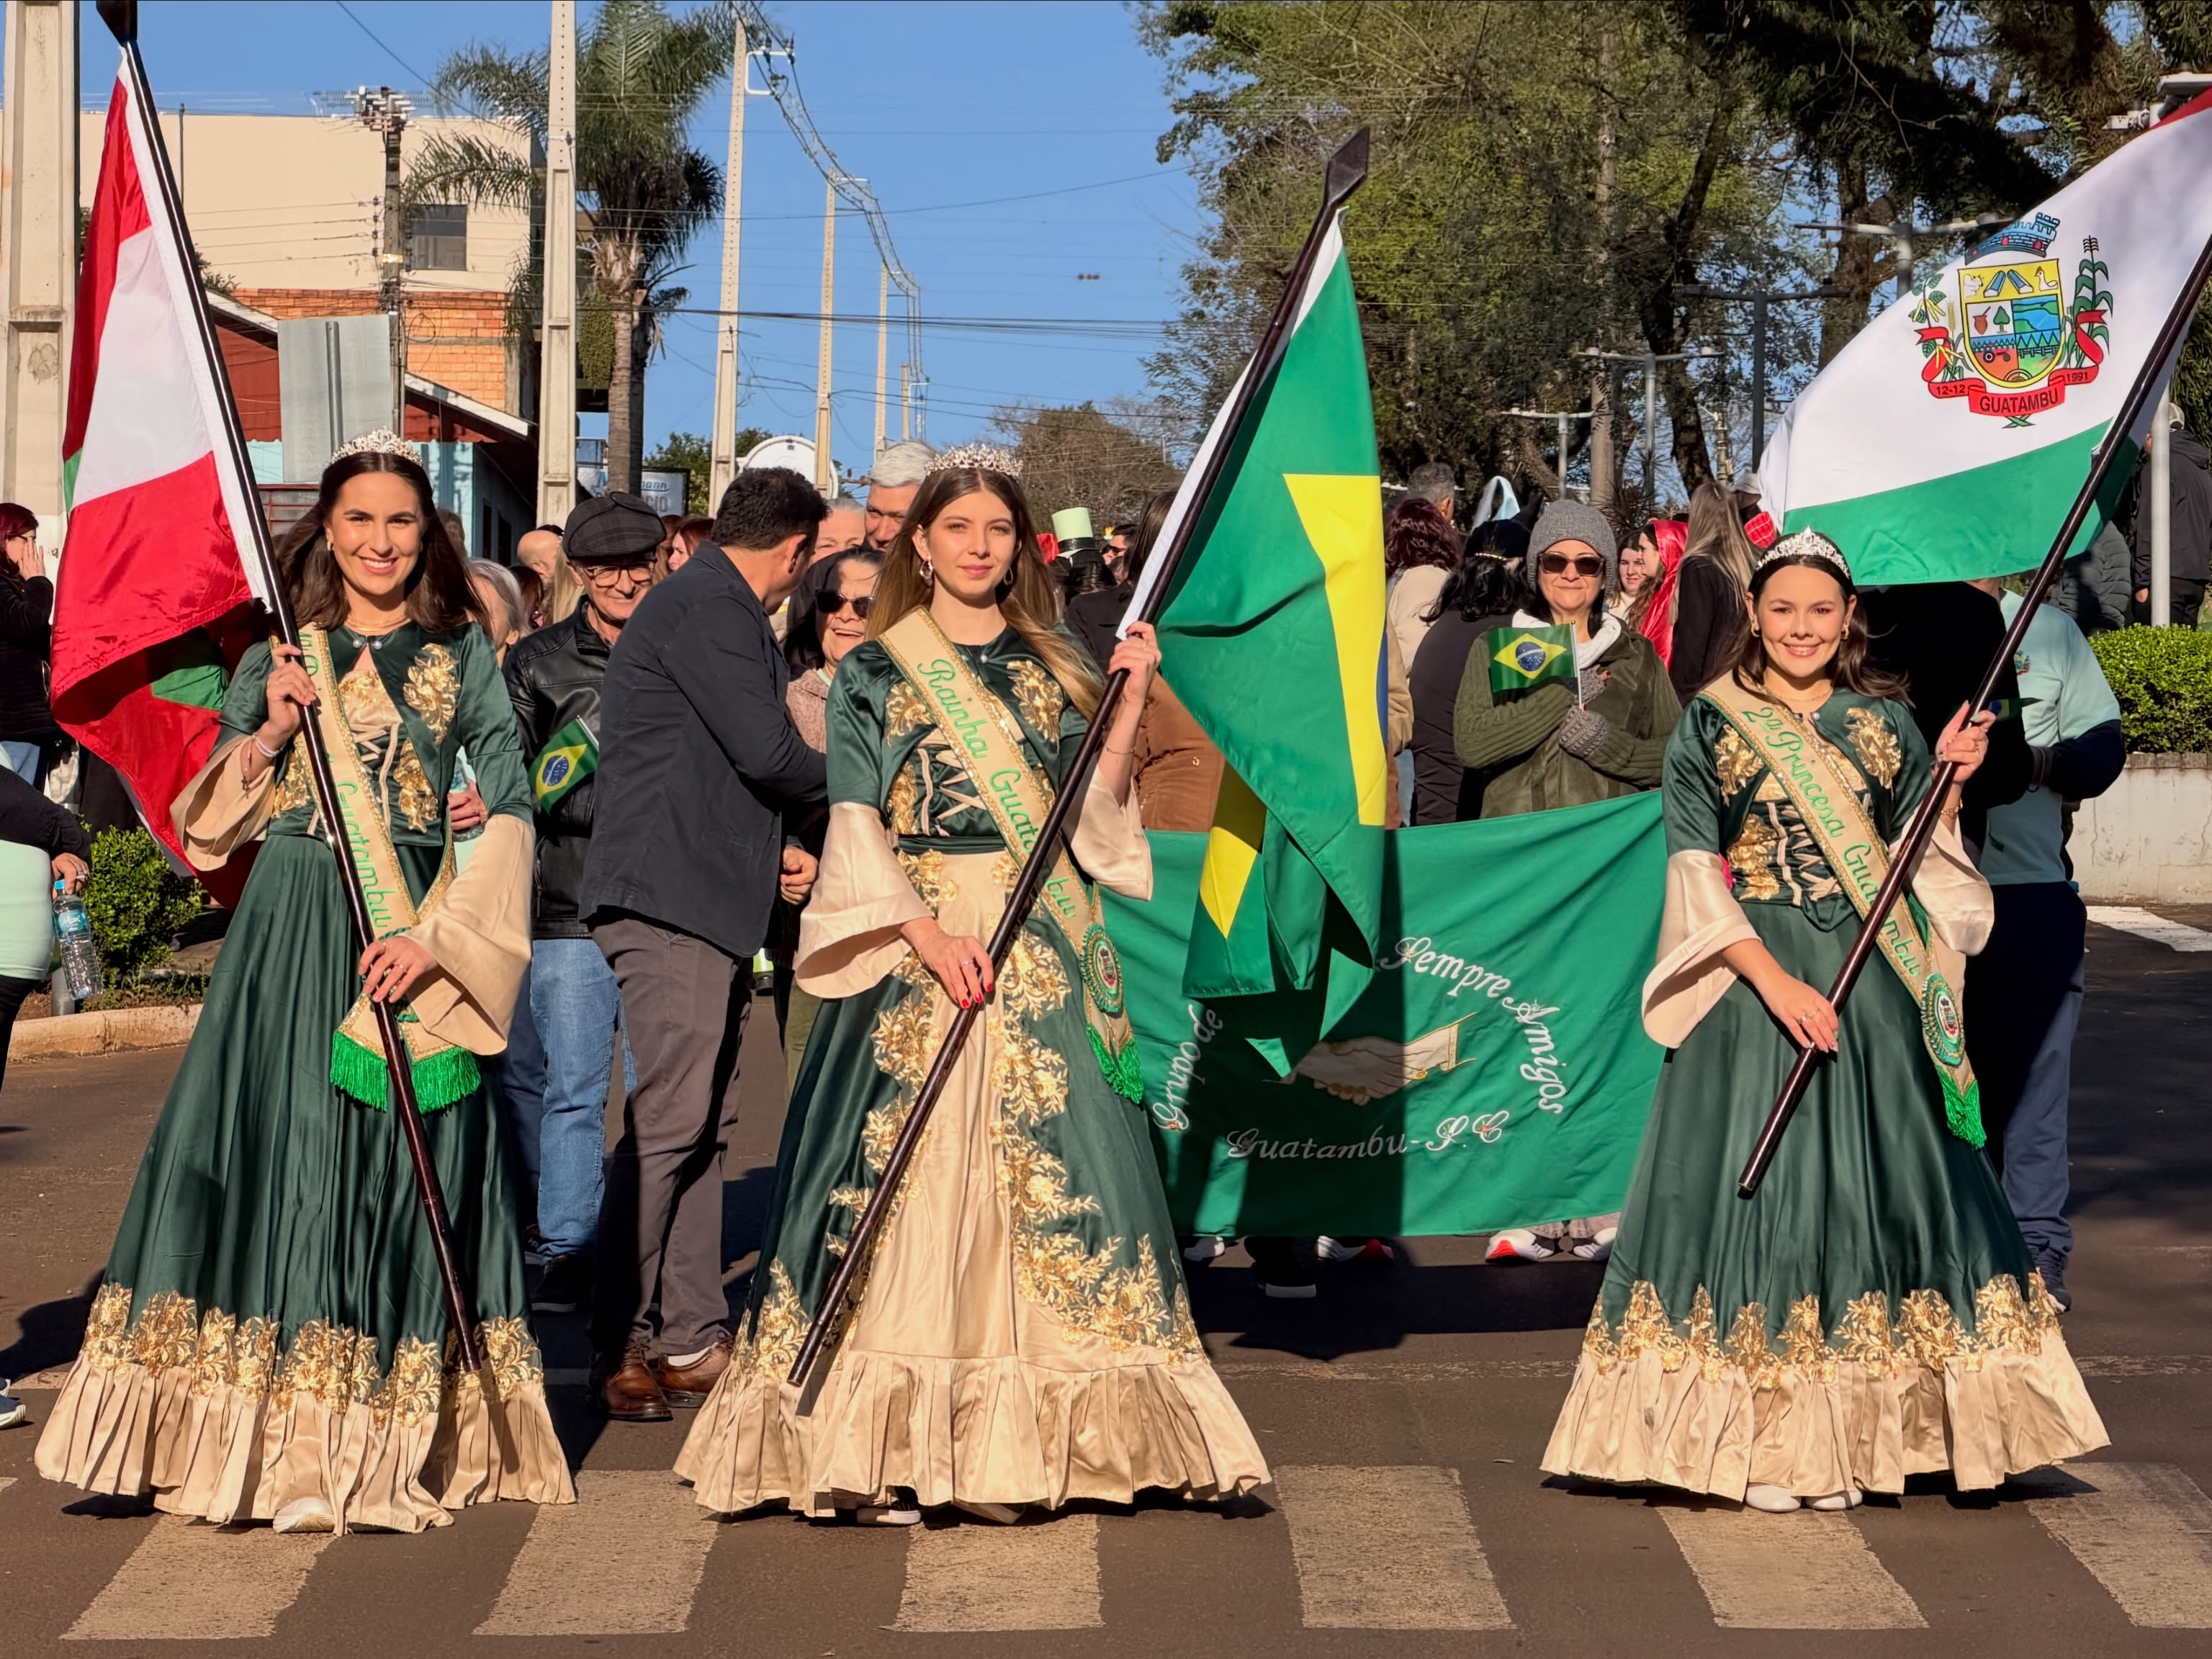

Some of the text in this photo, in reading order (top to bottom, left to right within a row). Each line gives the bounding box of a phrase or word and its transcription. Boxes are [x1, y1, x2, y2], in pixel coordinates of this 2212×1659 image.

[1979, 388, 2059, 413] GUATAMBU
[2067, 372, 2088, 382] 1991
[917, 658, 991, 760] Rainha
[1766, 730, 1845, 838] Princesa
[1843, 843, 1920, 977] Guambu
[1153, 1004, 1223, 1132] Grupo de
[1378, 937, 1567, 1115] Sempre Amigos
